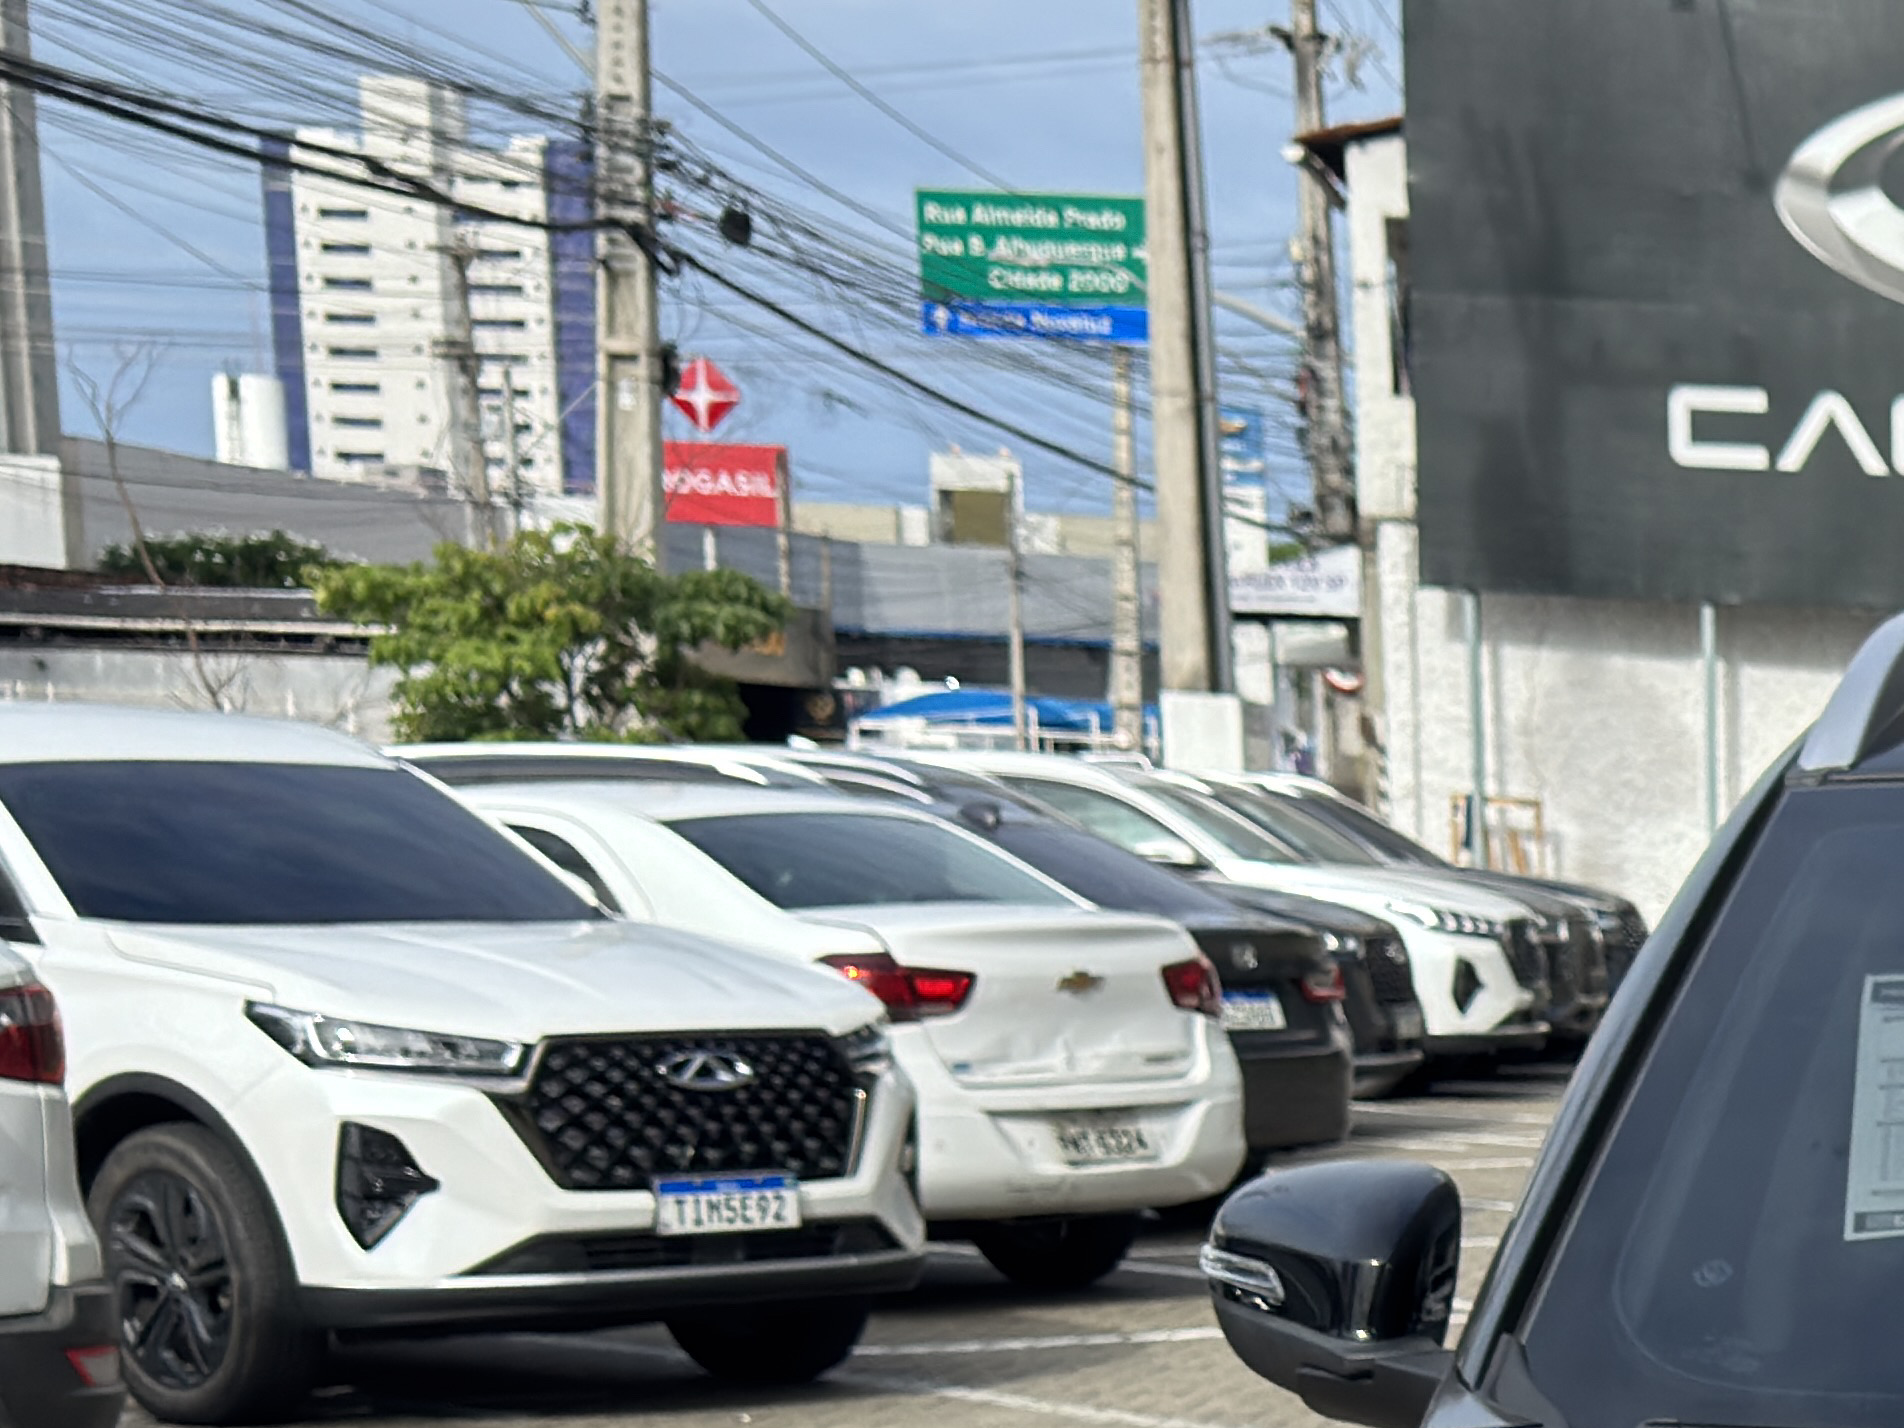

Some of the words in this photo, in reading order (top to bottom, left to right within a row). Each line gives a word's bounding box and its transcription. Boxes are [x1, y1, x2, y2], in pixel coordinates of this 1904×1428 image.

[923, 201, 967, 225] Rua
[971, 203, 1060, 229] Almeida
[1063, 207, 1127, 232] Prado
[987, 265, 1064, 292] Cidade
[1068, 268, 1130, 294] 2000
